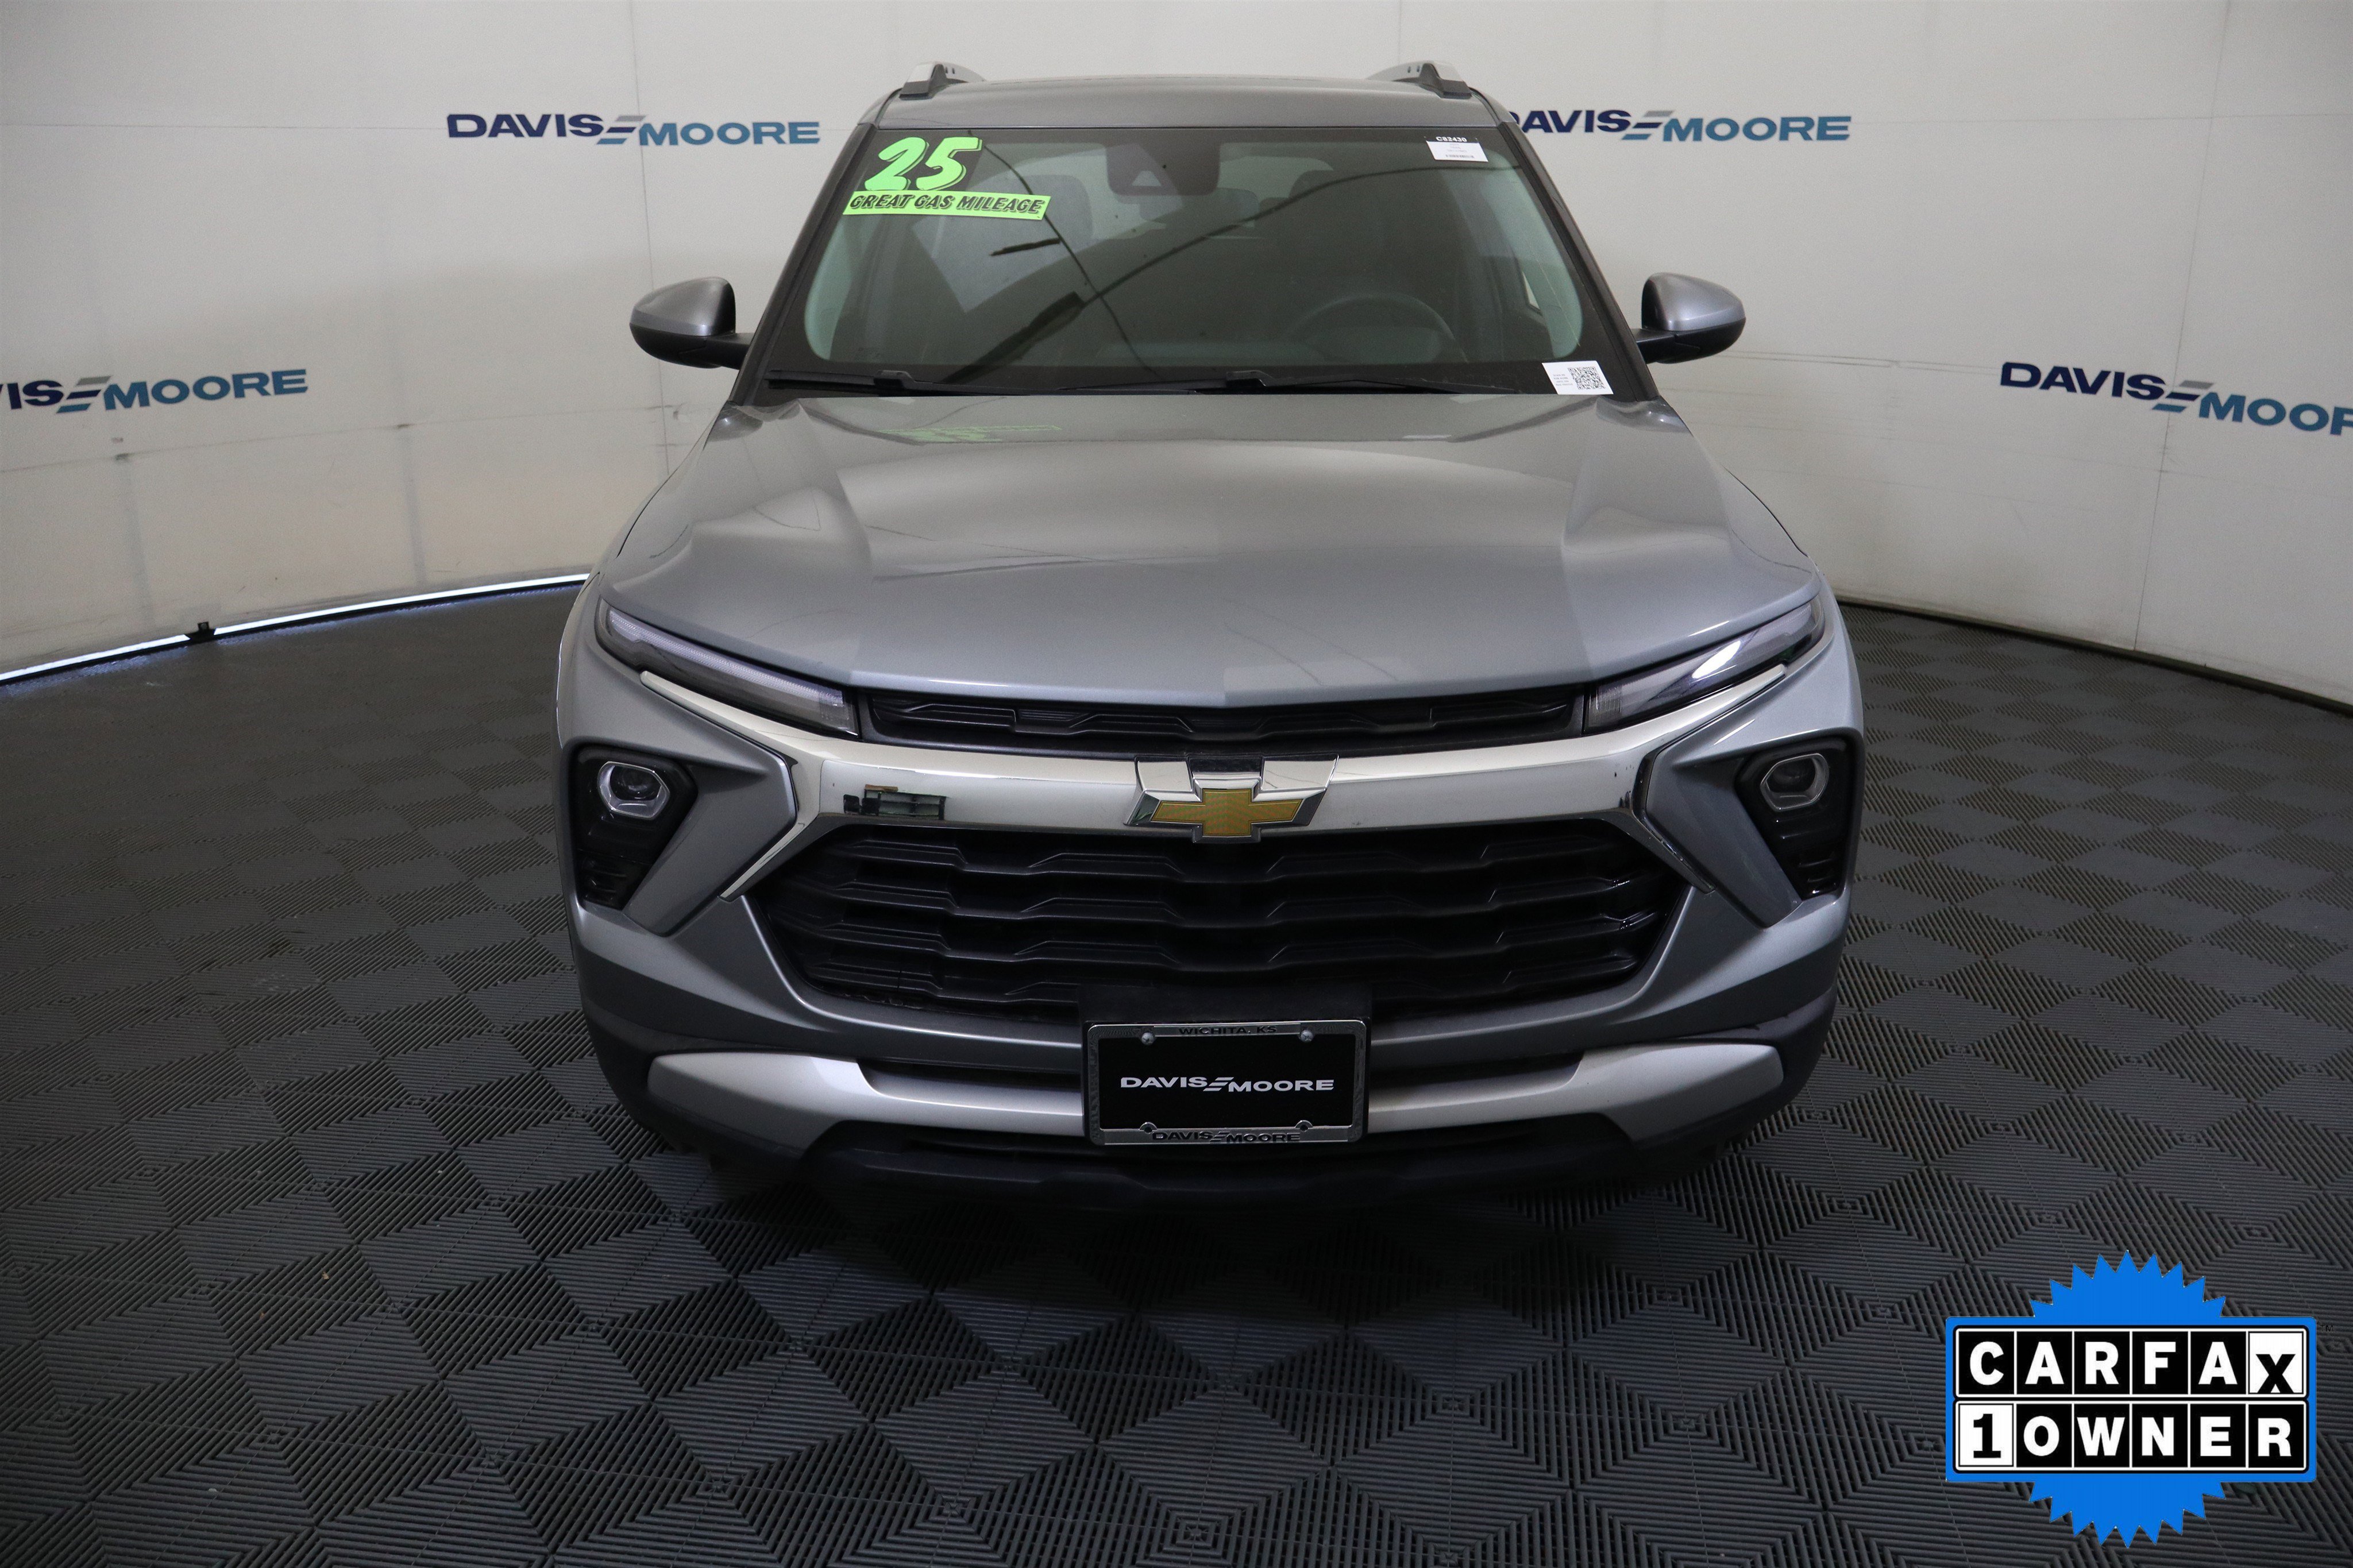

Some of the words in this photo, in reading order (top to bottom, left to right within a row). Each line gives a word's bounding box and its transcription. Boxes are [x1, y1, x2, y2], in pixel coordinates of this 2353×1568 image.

[446, 113, 604, 138] DAVIS
[639, 121, 820, 146] MOORE
[1663, 115, 1851, 142] MOORE
[865, 136, 983, 191] 25
[850, 194, 914, 210] GREAT
[914, 194, 955, 209] GAS
[956, 195, 1046, 214] MILEAGE
[103, 369, 308, 411] MOORE
[2000, 361, 2166, 401] DAVIS
[1256, 1025, 1277, 1033] KS
[1120, 1076, 1208, 1088] DAVIS
[1228, 1079, 1334, 1092] MOORE
[1152, 1131, 1213, 1141] DAVIS
[1226, 1132, 1301, 1142] MOORE
